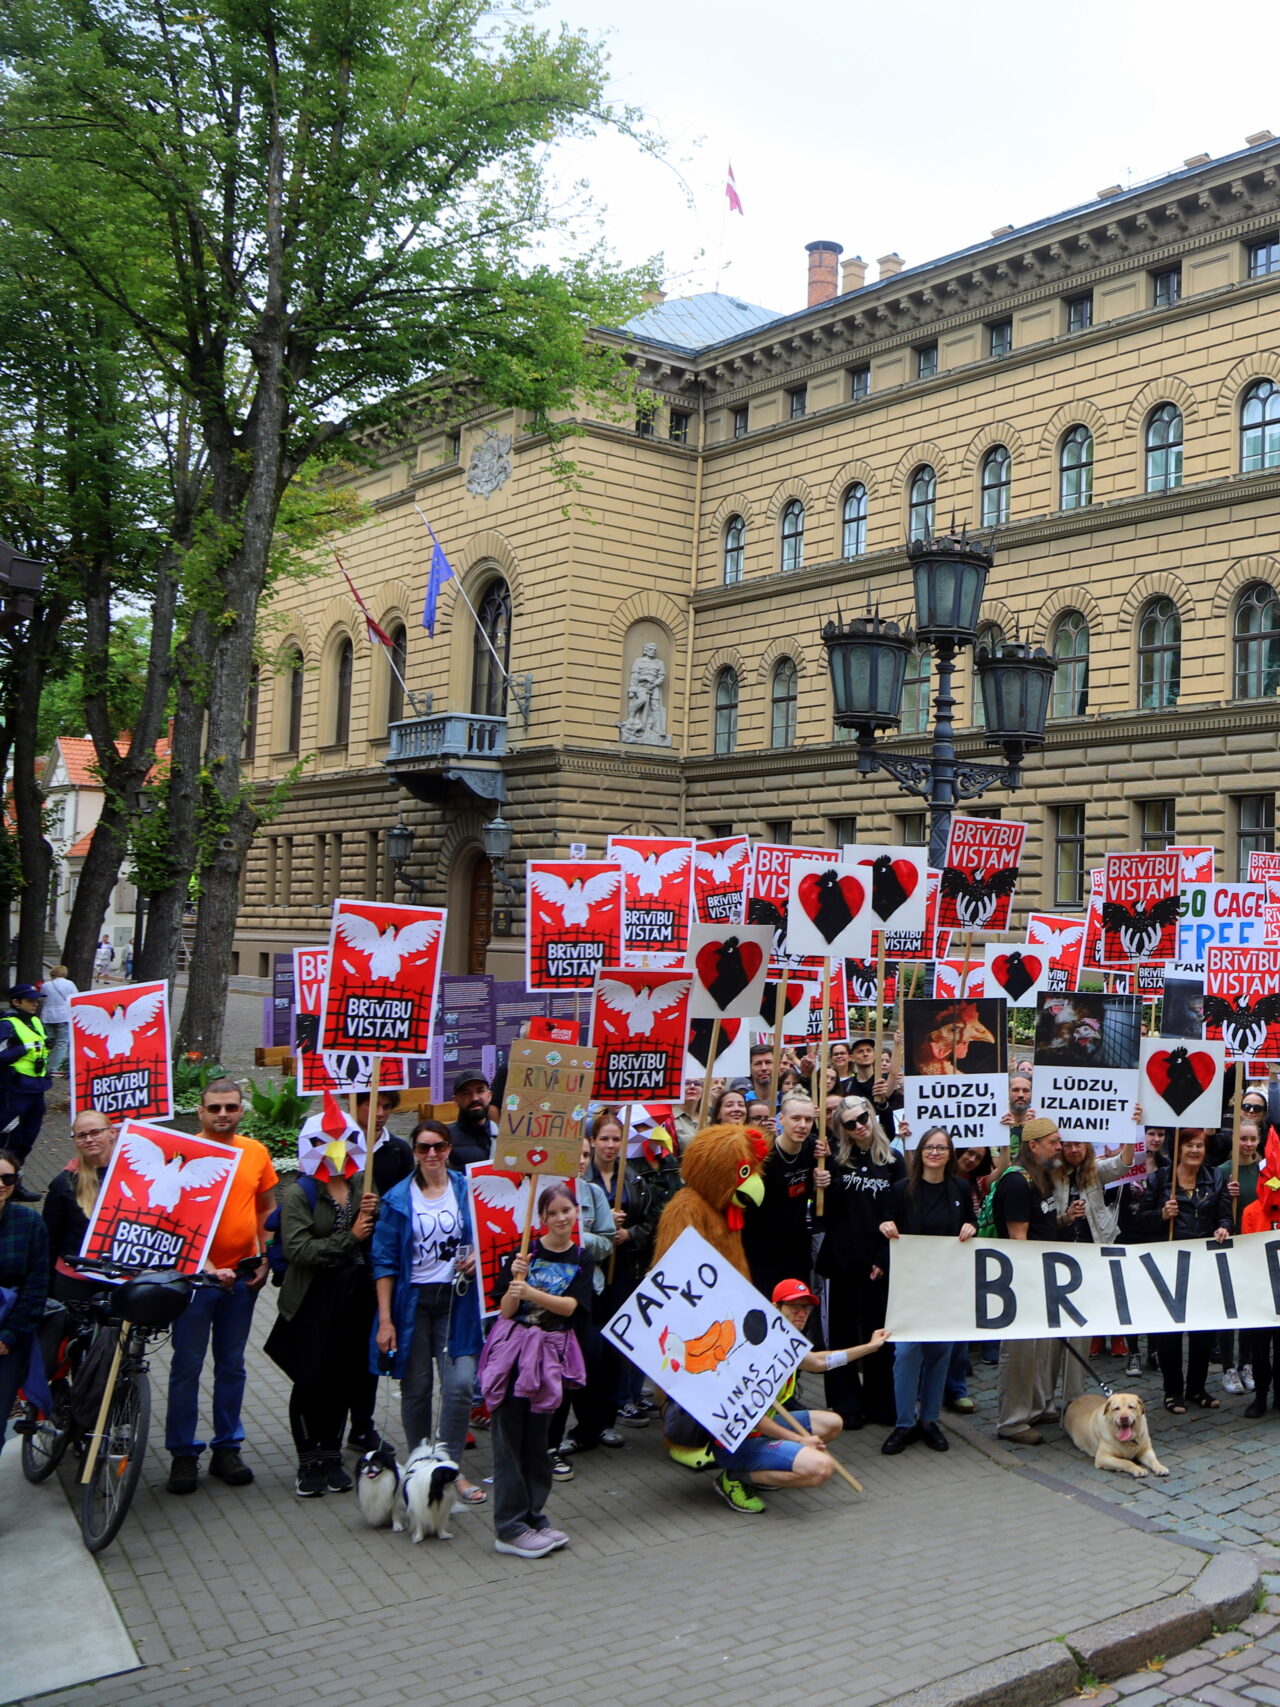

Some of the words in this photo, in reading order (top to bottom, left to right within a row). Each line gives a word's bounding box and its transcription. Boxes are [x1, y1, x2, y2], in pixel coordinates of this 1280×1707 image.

[953, 822, 1022, 847] BRĪVĪBU
[952, 845, 1016, 869] VISTĀM
[1108, 856, 1177, 878] BRĪVĪBU
[757, 874, 789, 898] VIS
[1108, 878, 1175, 900] VISTĀM
[1214, 888, 1265, 918] CAGE
[625, 910, 673, 926] BRĪVĪBU
[625, 926, 672, 941] VISTĀM
[548, 944, 604, 959] BRĪVĪBU
[884, 937, 921, 951] VISTĀM
[548, 958, 602, 976] VISTĀM
[1210, 950, 1280, 971] BRĪVĪBU
[1139, 967, 1165, 978] BRĪVĪB
[1139, 978, 1164, 988] VISTĀ
[1210, 974, 1279, 994] VISTĀM
[348, 998, 412, 1018] BRĪVĪBU
[347, 1017, 410, 1039] VISTĀM
[609, 1052, 666, 1070] BRĪVĪBU
[93, 1070, 148, 1094] BRĪVĪBU
[608, 1070, 664, 1088] VISTĀM
[1053, 1076, 1118, 1095] LŪDZU,
[94, 1088, 148, 1112] VISTĀM
[919, 1081, 995, 1100] LŪDZU,
[917, 1102, 997, 1120] PALĪDZI
[1041, 1096, 1128, 1112] IZLAIDIET
[507, 1110, 583, 1140] VISTĀM!
[932, 1124, 984, 1139] AN!
[1058, 1116, 1109, 1131] MANI!
[116, 1222, 184, 1255] BRĪVĪBU
[112, 1242, 176, 1266] VISTĀM
[680, 1263, 718, 1308] KO
[610, 1270, 679, 1351] PAR
[720, 1338, 808, 1446] IESLODZĪJA
